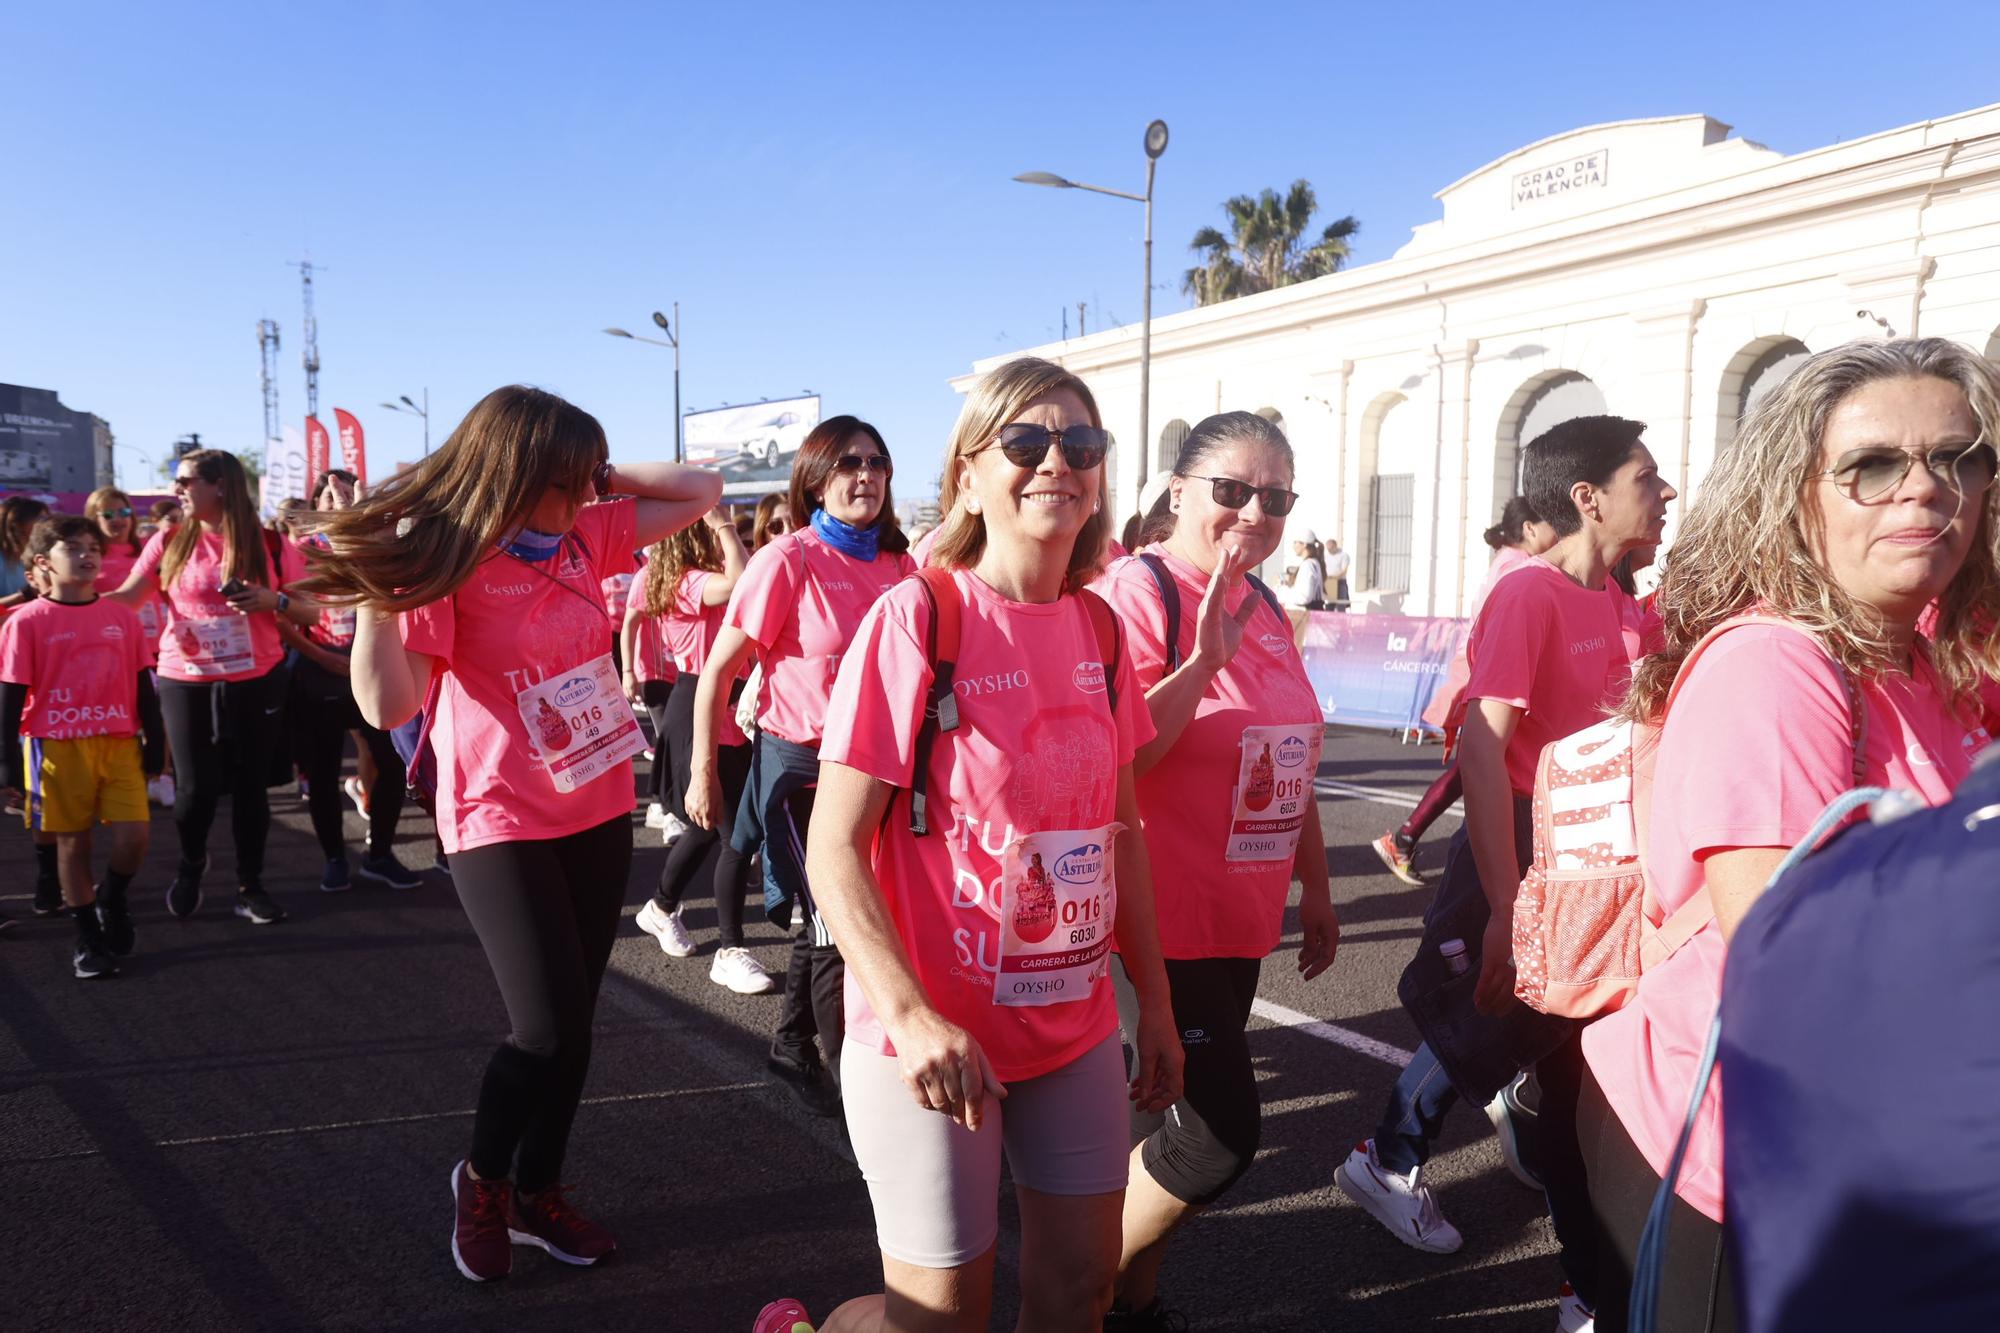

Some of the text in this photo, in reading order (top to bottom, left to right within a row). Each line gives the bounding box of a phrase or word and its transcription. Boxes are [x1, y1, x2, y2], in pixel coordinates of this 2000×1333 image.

[1521, 156, 1598, 188] GRAO DE
[1517, 171, 1600, 202] VALENCIA
[1387, 632, 1407, 652] la
[1570, 636, 1606, 656] OYSHO
[1383, 659, 1448, 675] CÁNCER DE
[504, 665, 545, 693] TU
[953, 669, 1030, 698] OYSHO
[47, 704, 129, 725] DORSAL
[571, 706, 602, 731] 016
[565, 762, 595, 784] OYSHO
[1276, 778, 1302, 799] 016
[1280, 801, 1297, 815] 6029
[957, 814, 1013, 856] TU
[1245, 823, 1277, 832] CARRERA
[1278, 823, 1286, 831] DE
[1239, 841, 1276, 852] OYSHO
[1062, 894, 1100, 925] 016
[1070, 925, 1096, 944] 6030
[1020, 957, 1066, 969] CARRERA
[1068, 954, 1081, 964] DE
[1081, 951, 1091, 961] LA
[950, 967, 993, 987] CARRERA
[1013, 978, 1065, 995] OYSHO
